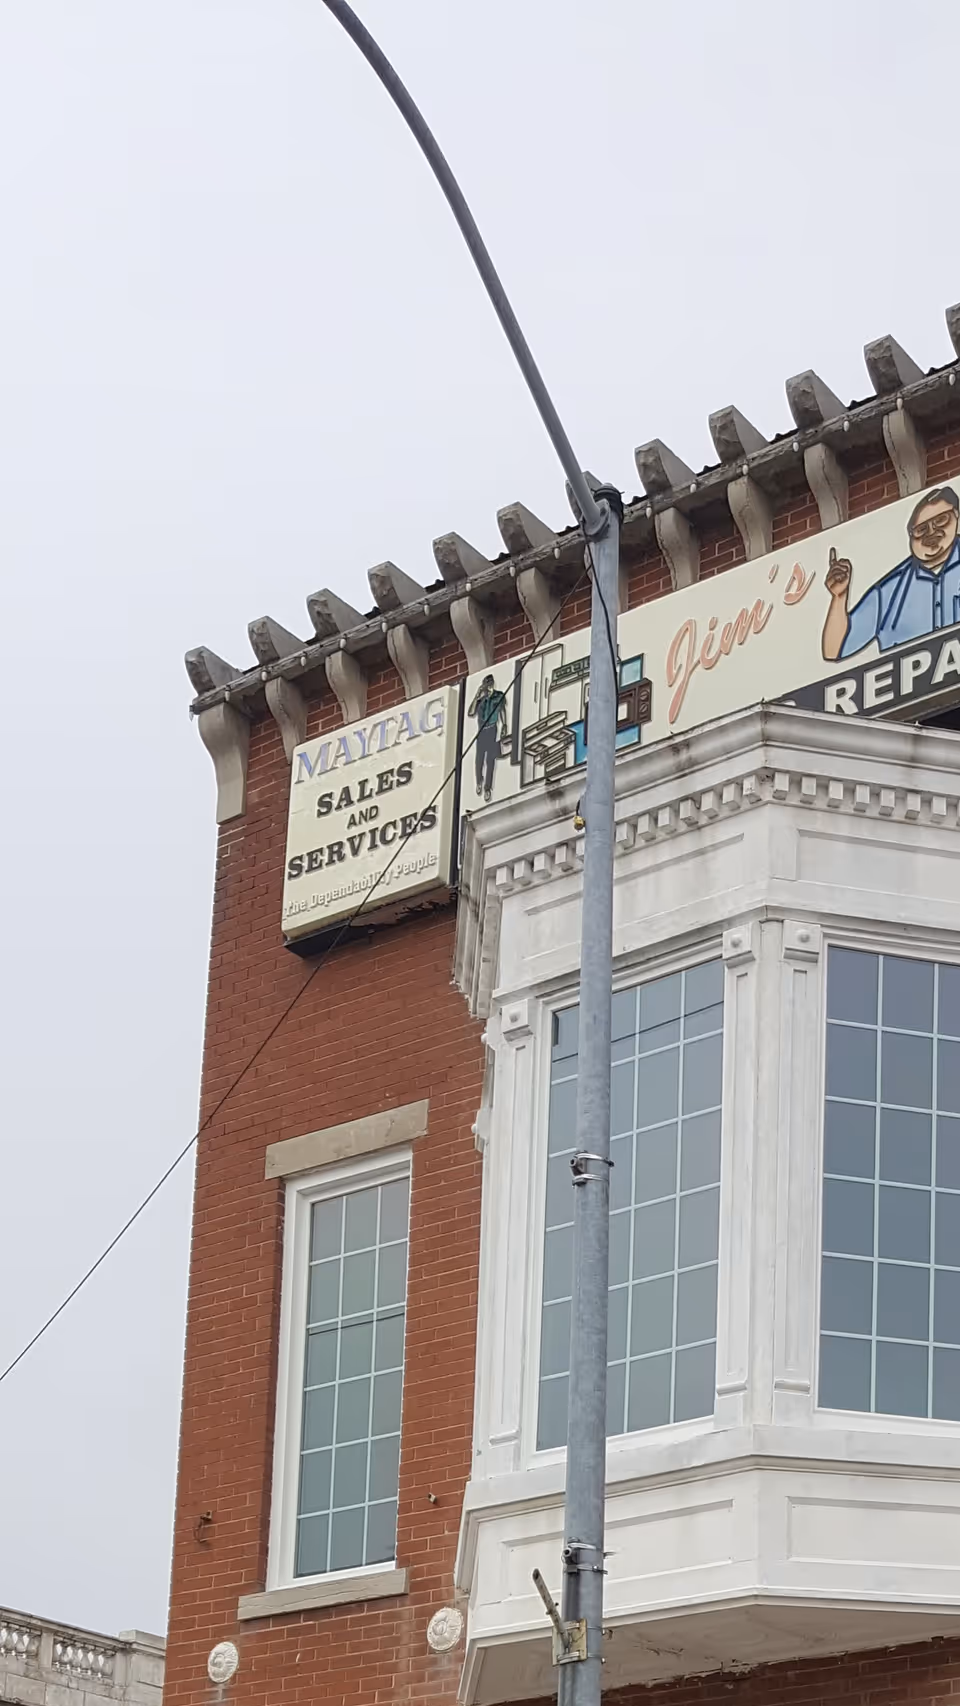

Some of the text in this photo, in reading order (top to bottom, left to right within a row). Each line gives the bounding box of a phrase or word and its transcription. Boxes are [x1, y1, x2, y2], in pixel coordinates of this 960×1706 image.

[666, 561, 816, 725] Jim's
[294, 696, 445, 784] MAYTAG
[316, 761, 413, 819] SALES
[346, 805, 379, 829] AND
[287, 804, 438, 880] SERVICES
[394, 852, 438, 880] People
